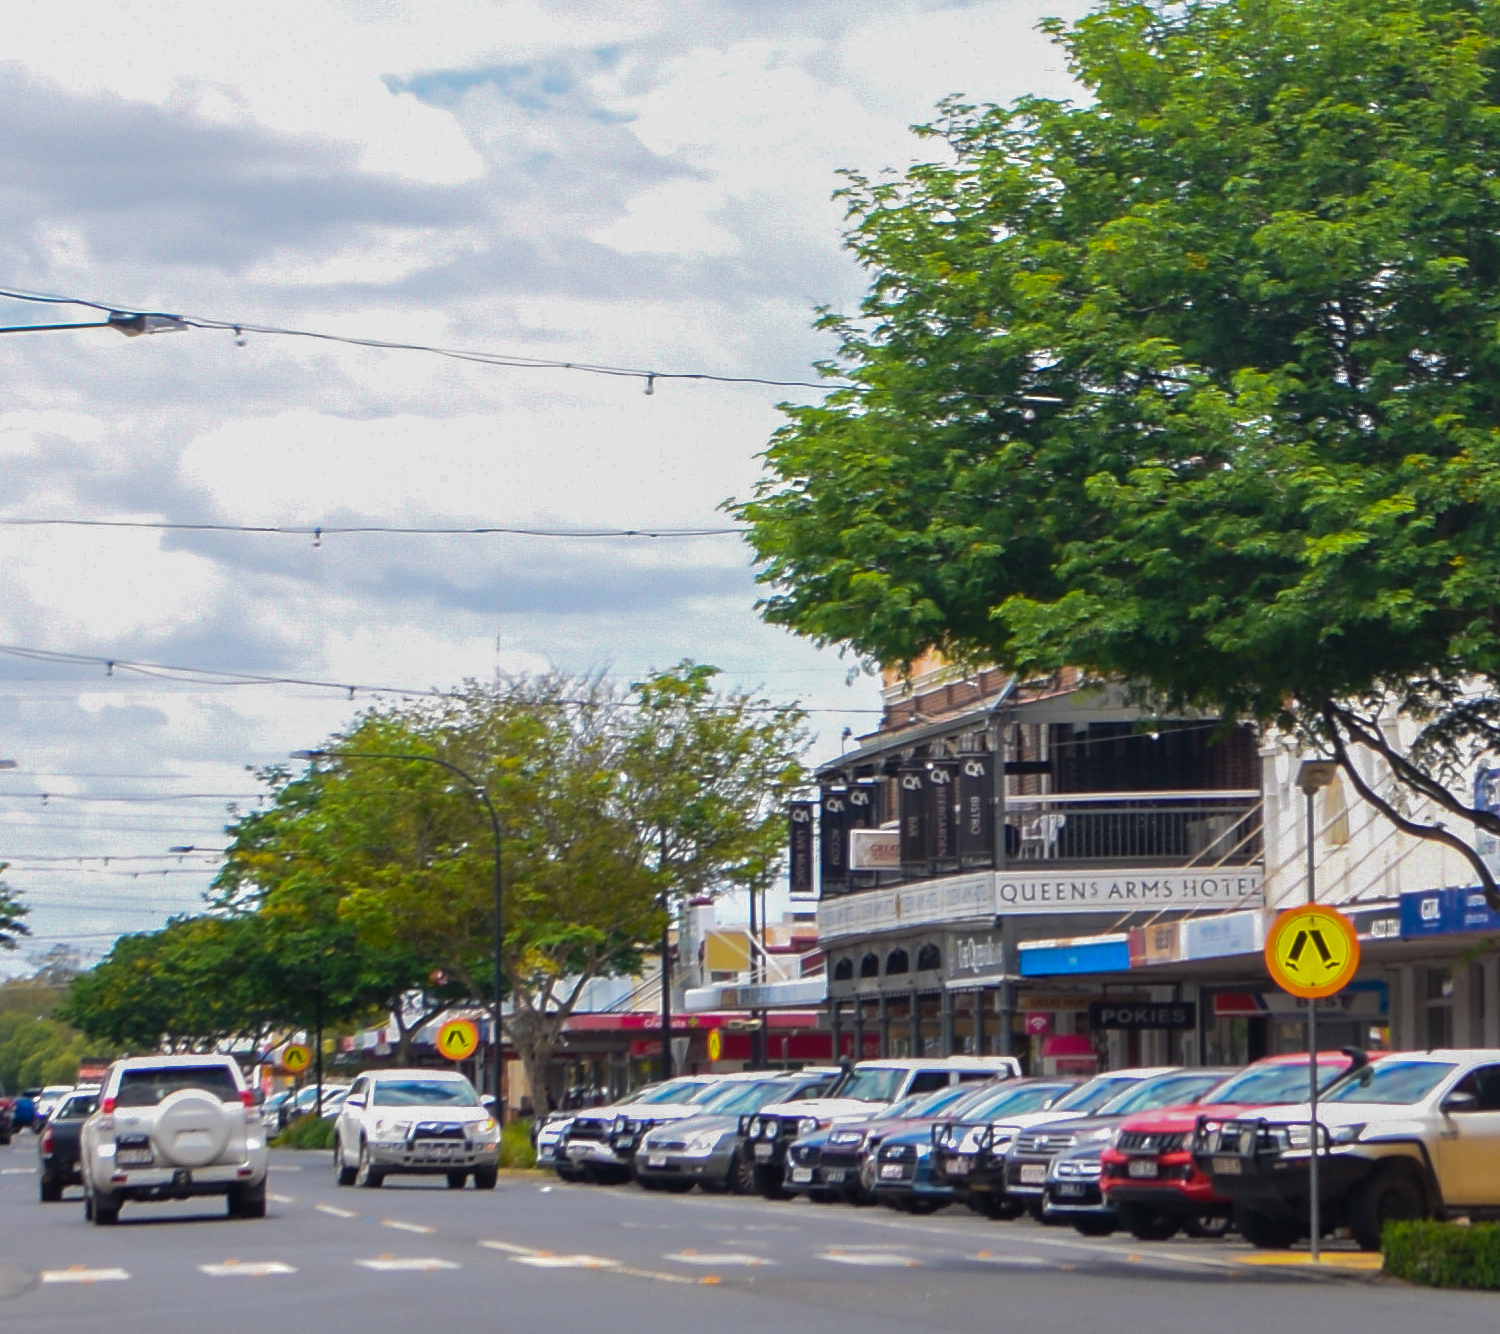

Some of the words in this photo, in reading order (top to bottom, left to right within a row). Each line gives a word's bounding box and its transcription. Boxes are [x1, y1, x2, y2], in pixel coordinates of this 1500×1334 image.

[908, 816, 919, 838] BAR
[970, 796, 981, 835] BISTRO
[1001, 881, 1098, 904] QUEENS
[1108, 879, 1173, 900] ARMS
[1183, 877, 1263, 899] HOTEL
[1101, 1008, 1187, 1024] POKIES
